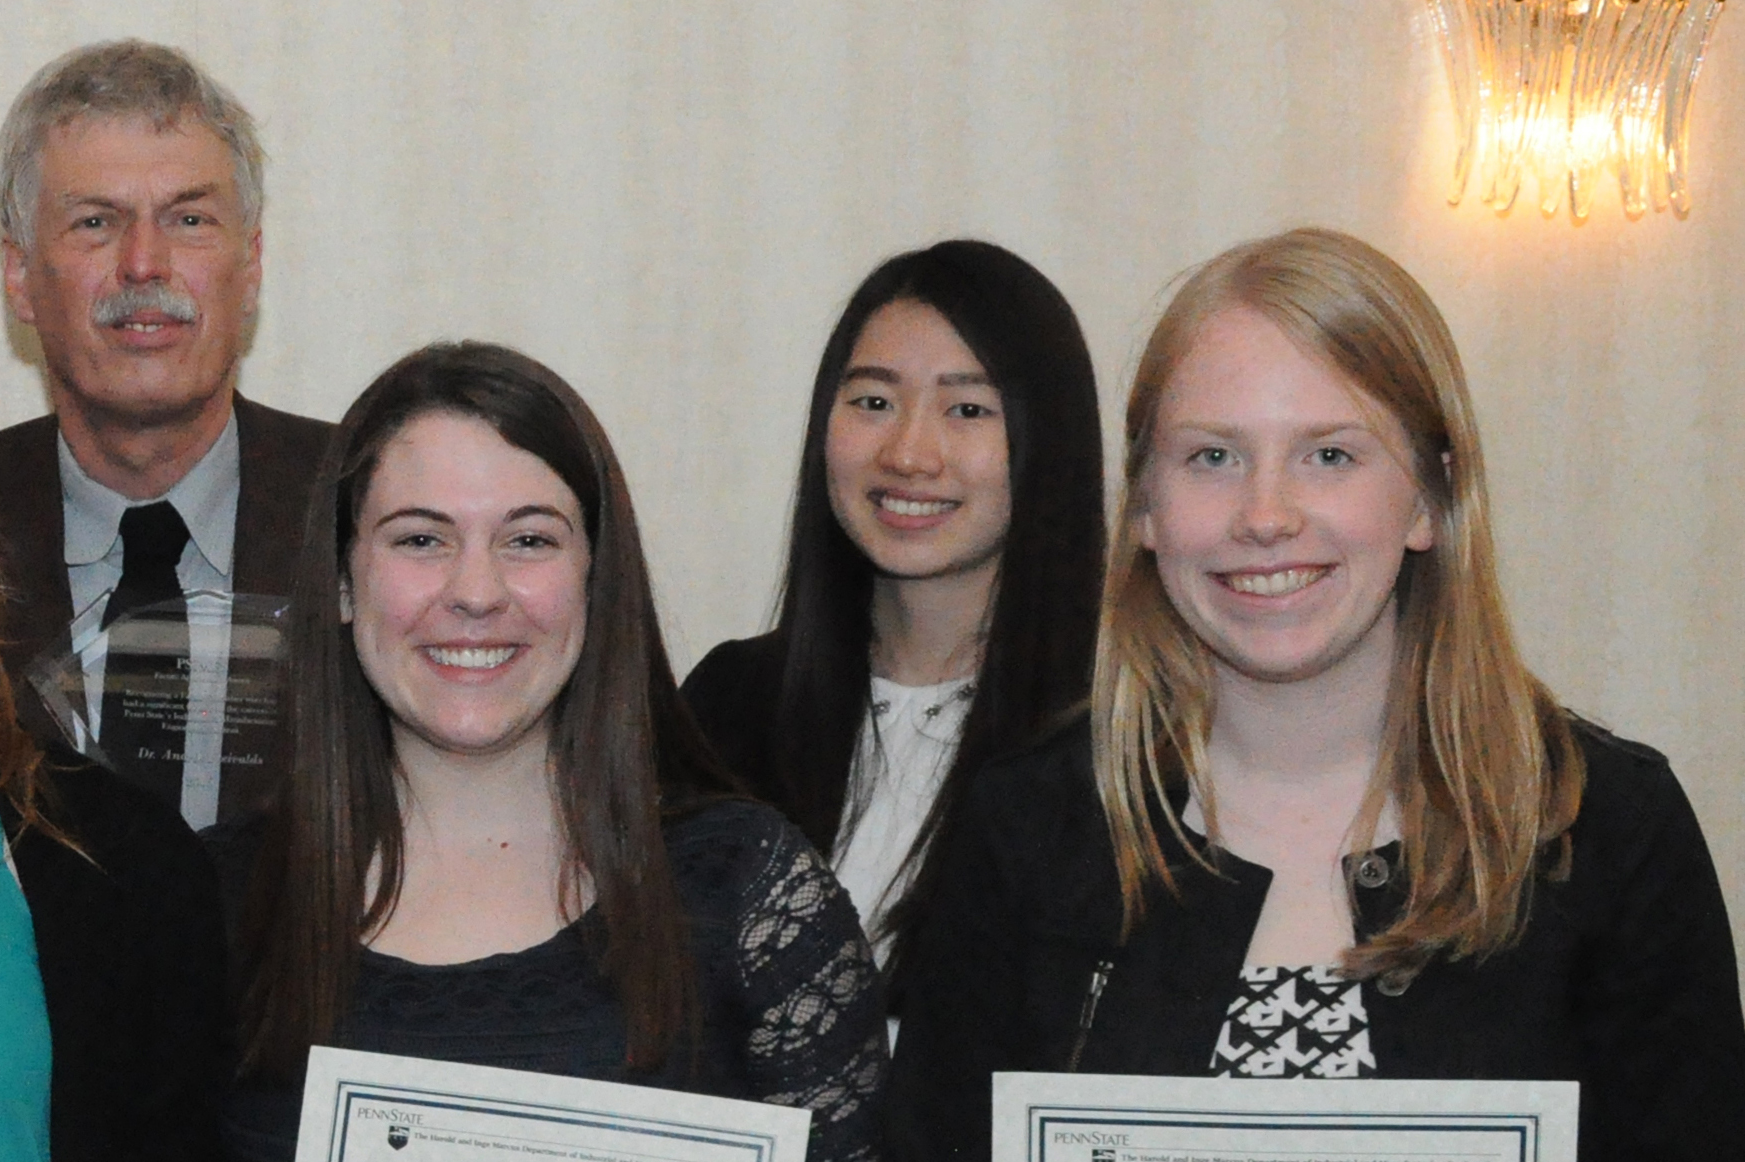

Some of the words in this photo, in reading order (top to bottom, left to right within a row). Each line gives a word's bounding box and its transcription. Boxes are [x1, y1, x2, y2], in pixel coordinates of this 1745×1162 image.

[415, 1132, 428, 1140] The
[430, 1133, 456, 1144] Harold
[474, 1139, 490, 1149] Inge
[492, 1141, 521, 1152] Marcus
[522, 1146, 567, 1158] Department
[569, 1151, 578, 1159] of
[579, 1152, 617, 1162] Industrial
[1122, 1154, 1138, 1162] The
[1140, 1154, 1170, 1162] Harold
